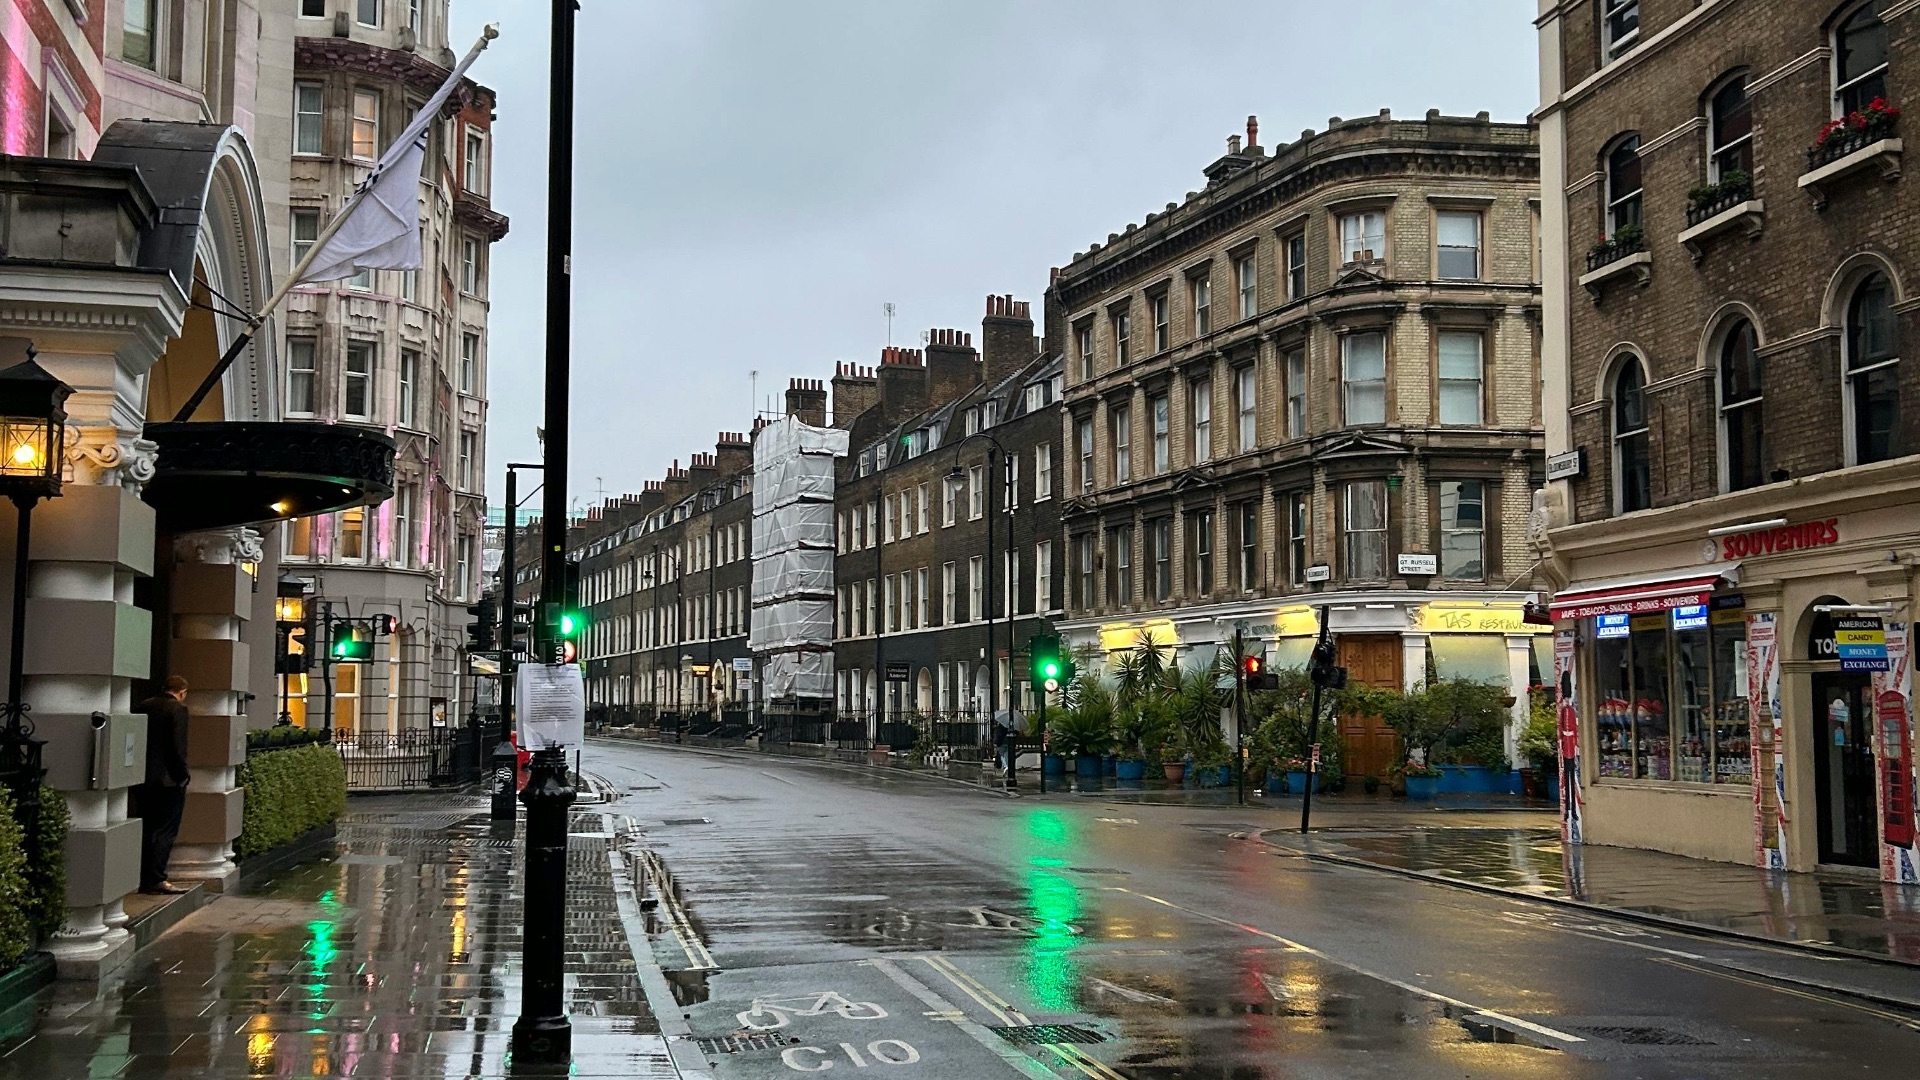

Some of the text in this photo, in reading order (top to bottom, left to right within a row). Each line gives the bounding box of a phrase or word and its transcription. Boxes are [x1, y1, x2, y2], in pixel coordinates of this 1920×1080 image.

[1723, 518, 1838, 560] SOUVENIRS
[1561, 595, 1699, 619] VAPE TOBACCO SNACKS DRINKS SOUVENIRS
[1439, 611, 1472, 629] TAS
[1847, 633, 1873, 641] CANDY
[1843, 661, 1888, 669] EXCHANGE
